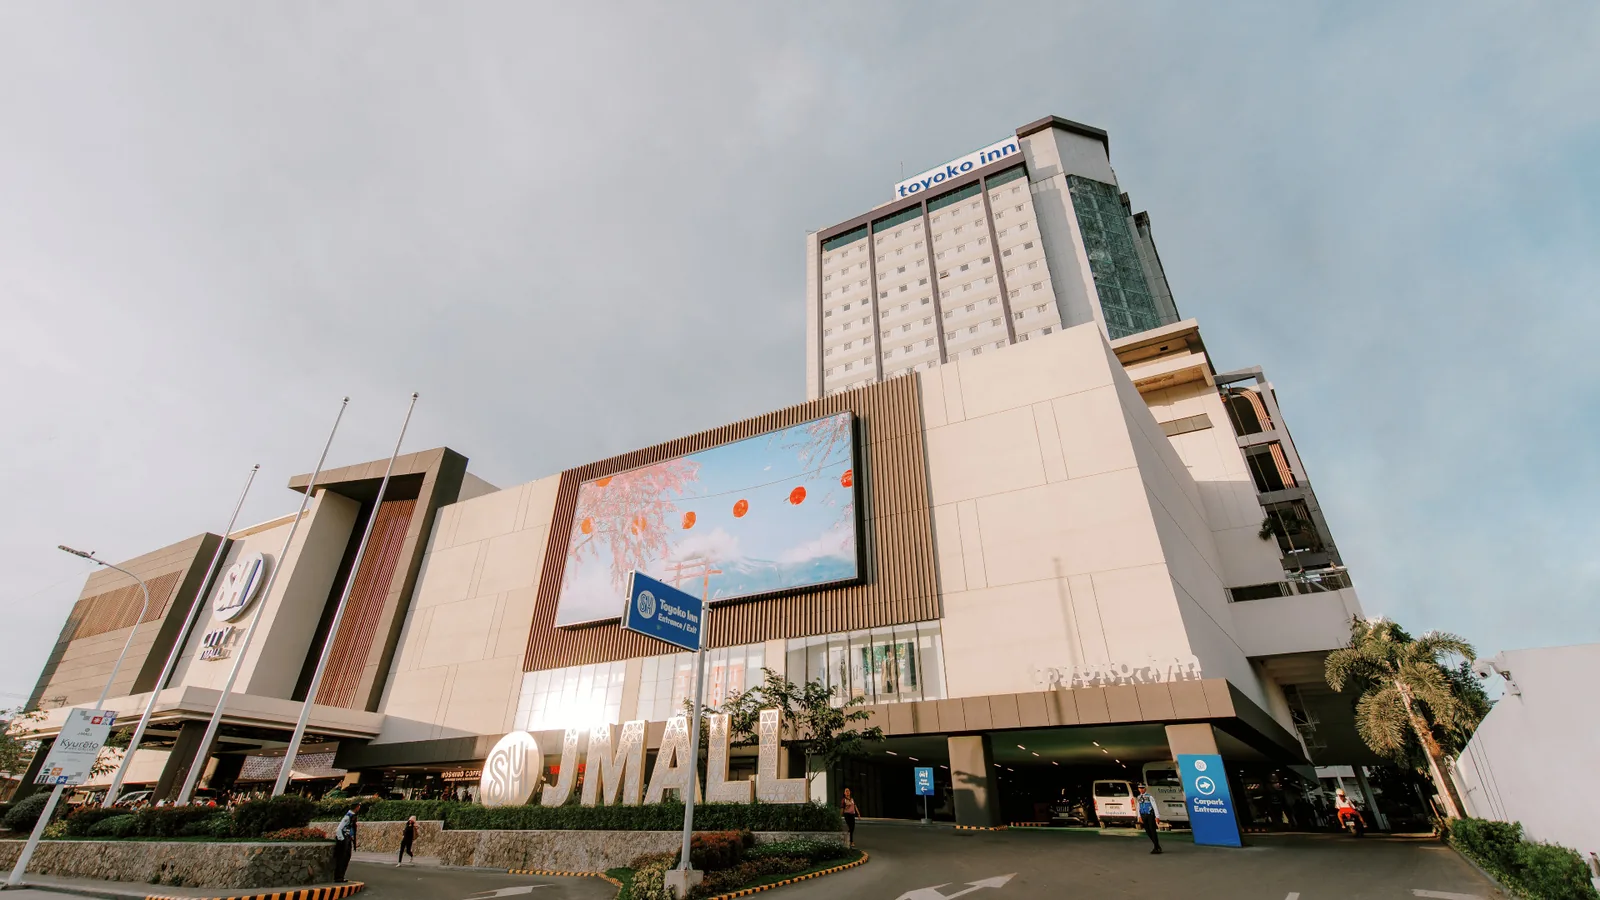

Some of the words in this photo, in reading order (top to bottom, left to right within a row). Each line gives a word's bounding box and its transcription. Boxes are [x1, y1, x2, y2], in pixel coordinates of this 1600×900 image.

[898, 161, 974, 198] toyoko
[980, 143, 1017, 166] inn
[659, 598, 687, 618] Toyoko
[687, 609, 698, 624] Inn
[658, 613, 684, 630] Entrance
[686, 623, 698, 636] Exit
[489, 740, 531, 803] SM
[1194, 797, 1225, 807] Carpark
[1194, 805, 1228, 814] Entrance
